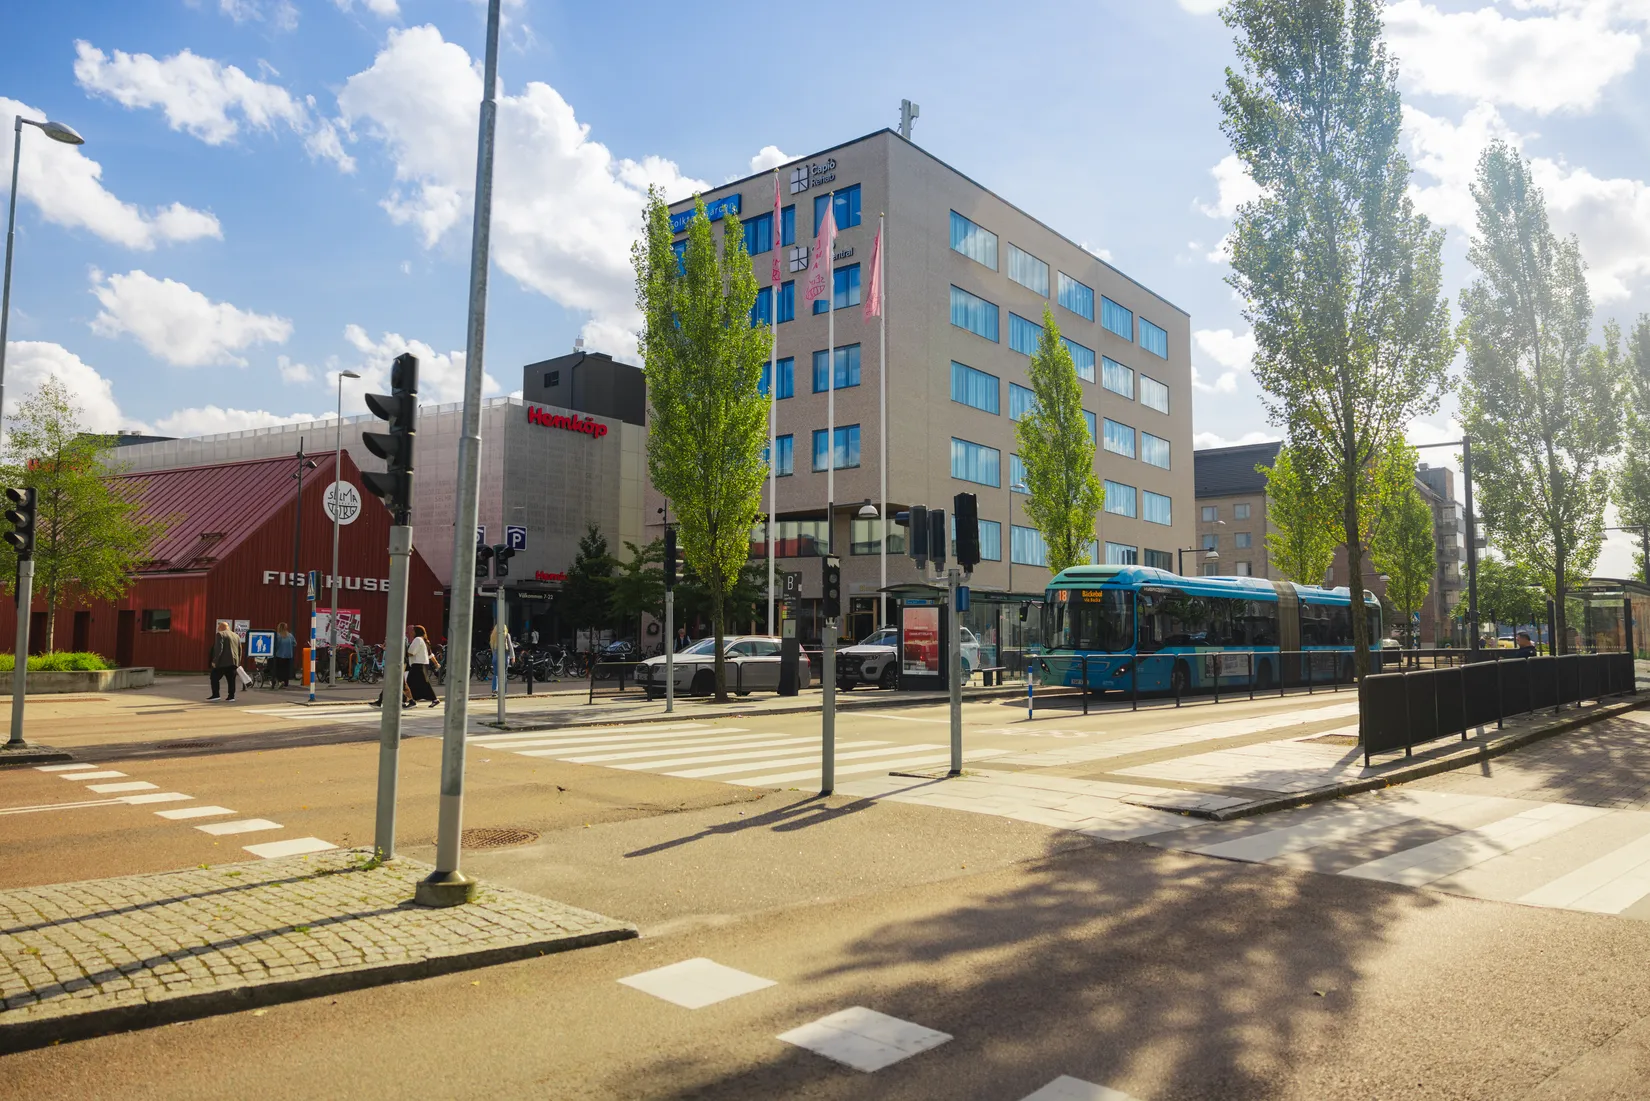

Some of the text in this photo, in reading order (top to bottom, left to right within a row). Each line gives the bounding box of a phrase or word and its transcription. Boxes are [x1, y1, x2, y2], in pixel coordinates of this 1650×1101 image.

[811, 160, 836, 175] Capio
[811, 173, 836, 187] Rehab
[528, 405, 608, 439] Hemköp
[328, 486, 358, 503] SLMA
[512, 533, 521, 548] P
[1059, 590, 1067, 602] 18
